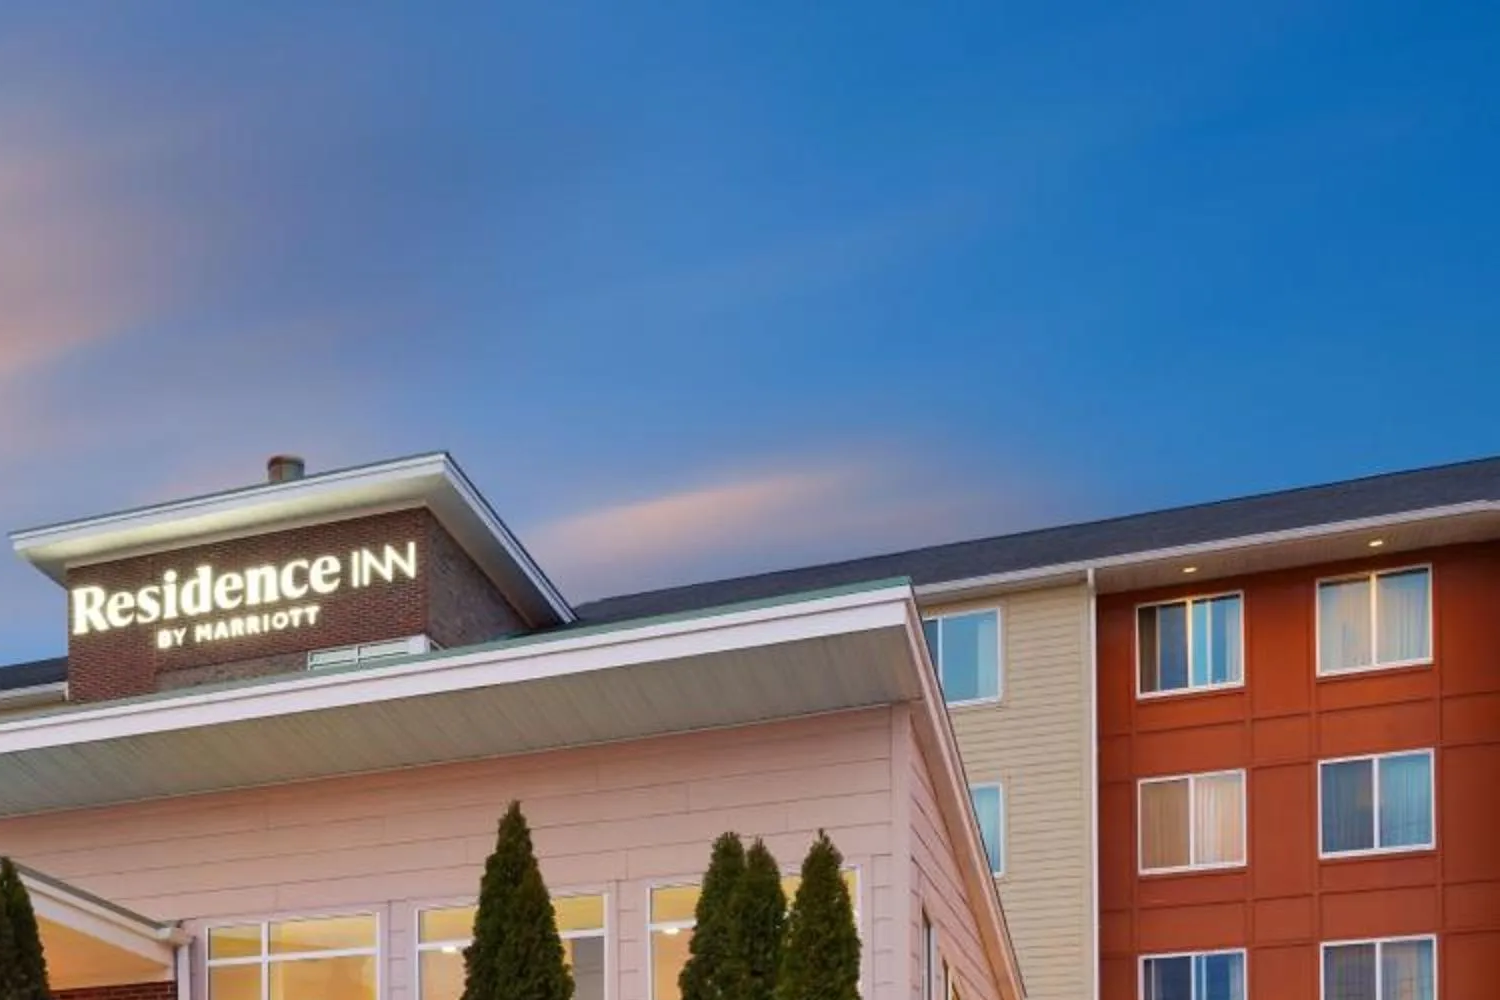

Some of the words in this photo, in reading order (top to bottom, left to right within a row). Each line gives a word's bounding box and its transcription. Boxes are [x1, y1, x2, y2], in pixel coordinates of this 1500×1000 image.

[72, 555, 341, 635] Residence
[351, 541, 417, 588] INN
[157, 627, 187, 649] BY
[195, 605, 320, 643] MARRIOTT
